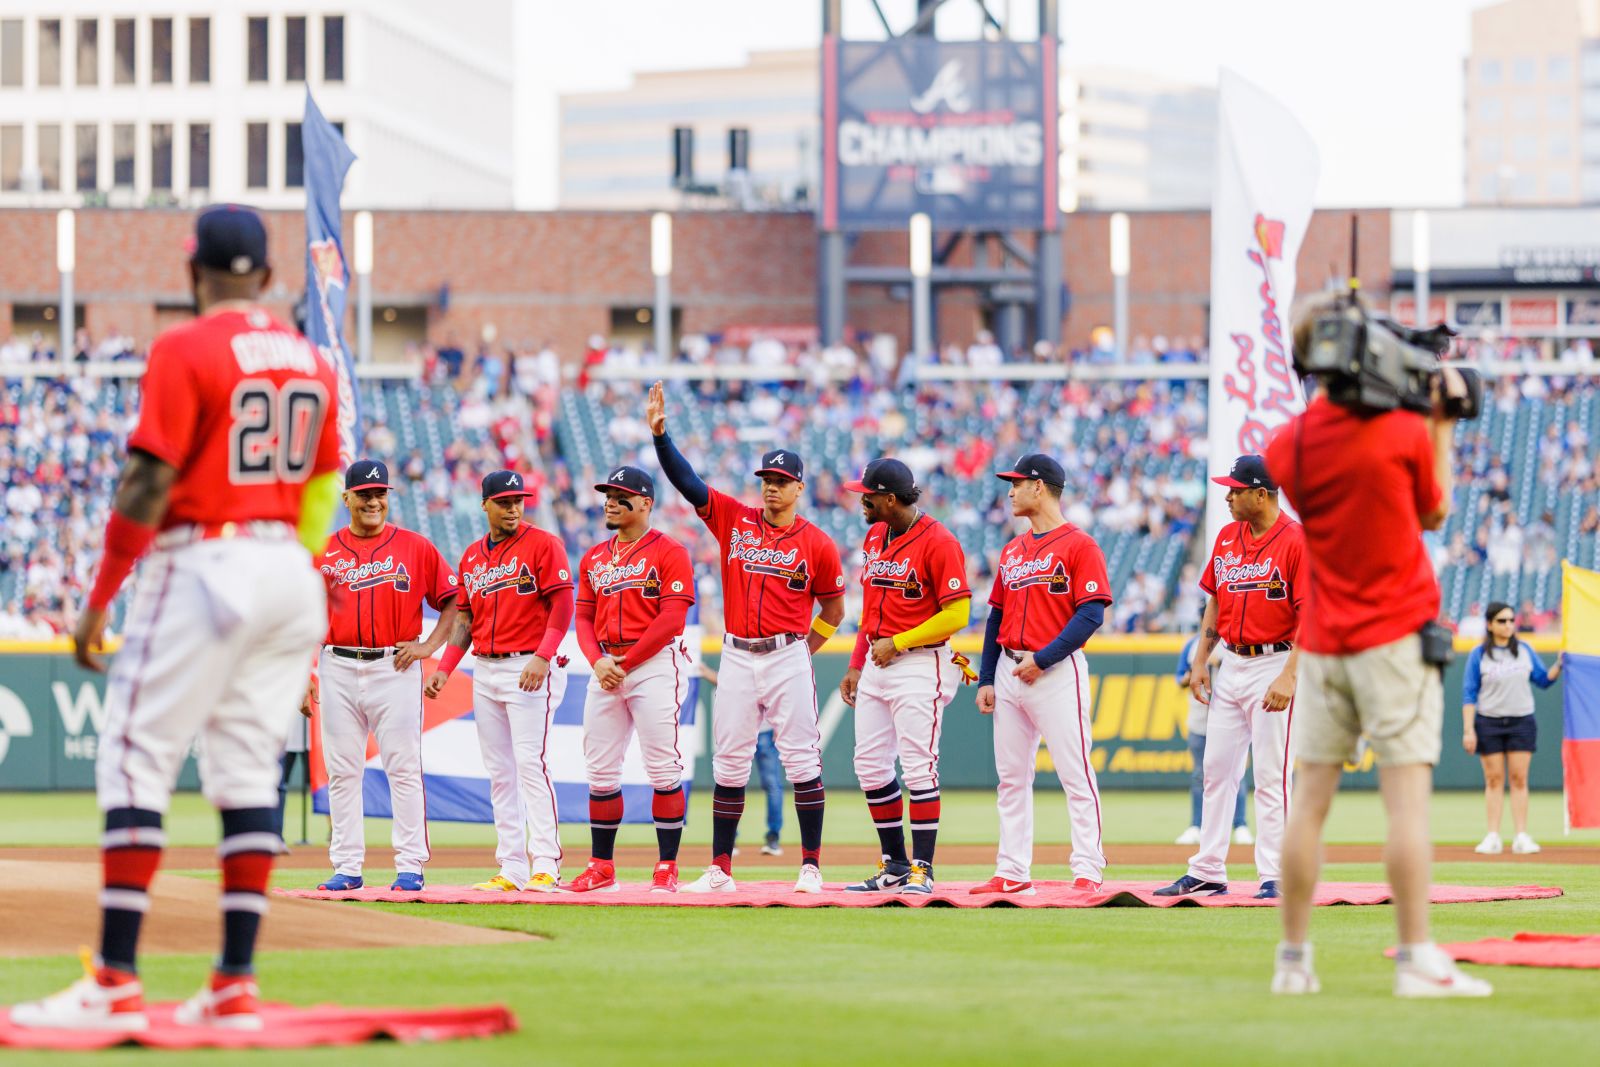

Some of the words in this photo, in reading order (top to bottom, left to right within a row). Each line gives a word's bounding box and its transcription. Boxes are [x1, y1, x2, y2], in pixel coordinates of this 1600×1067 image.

[838, 119, 1043, 168] CHAMPIONS
[1223, 332, 1257, 411] Los
[228, 378, 330, 486] 20
[728, 527, 799, 565] Bravos
[1223, 551, 1243, 566] Los
[1214, 556, 1273, 591] Bravos
